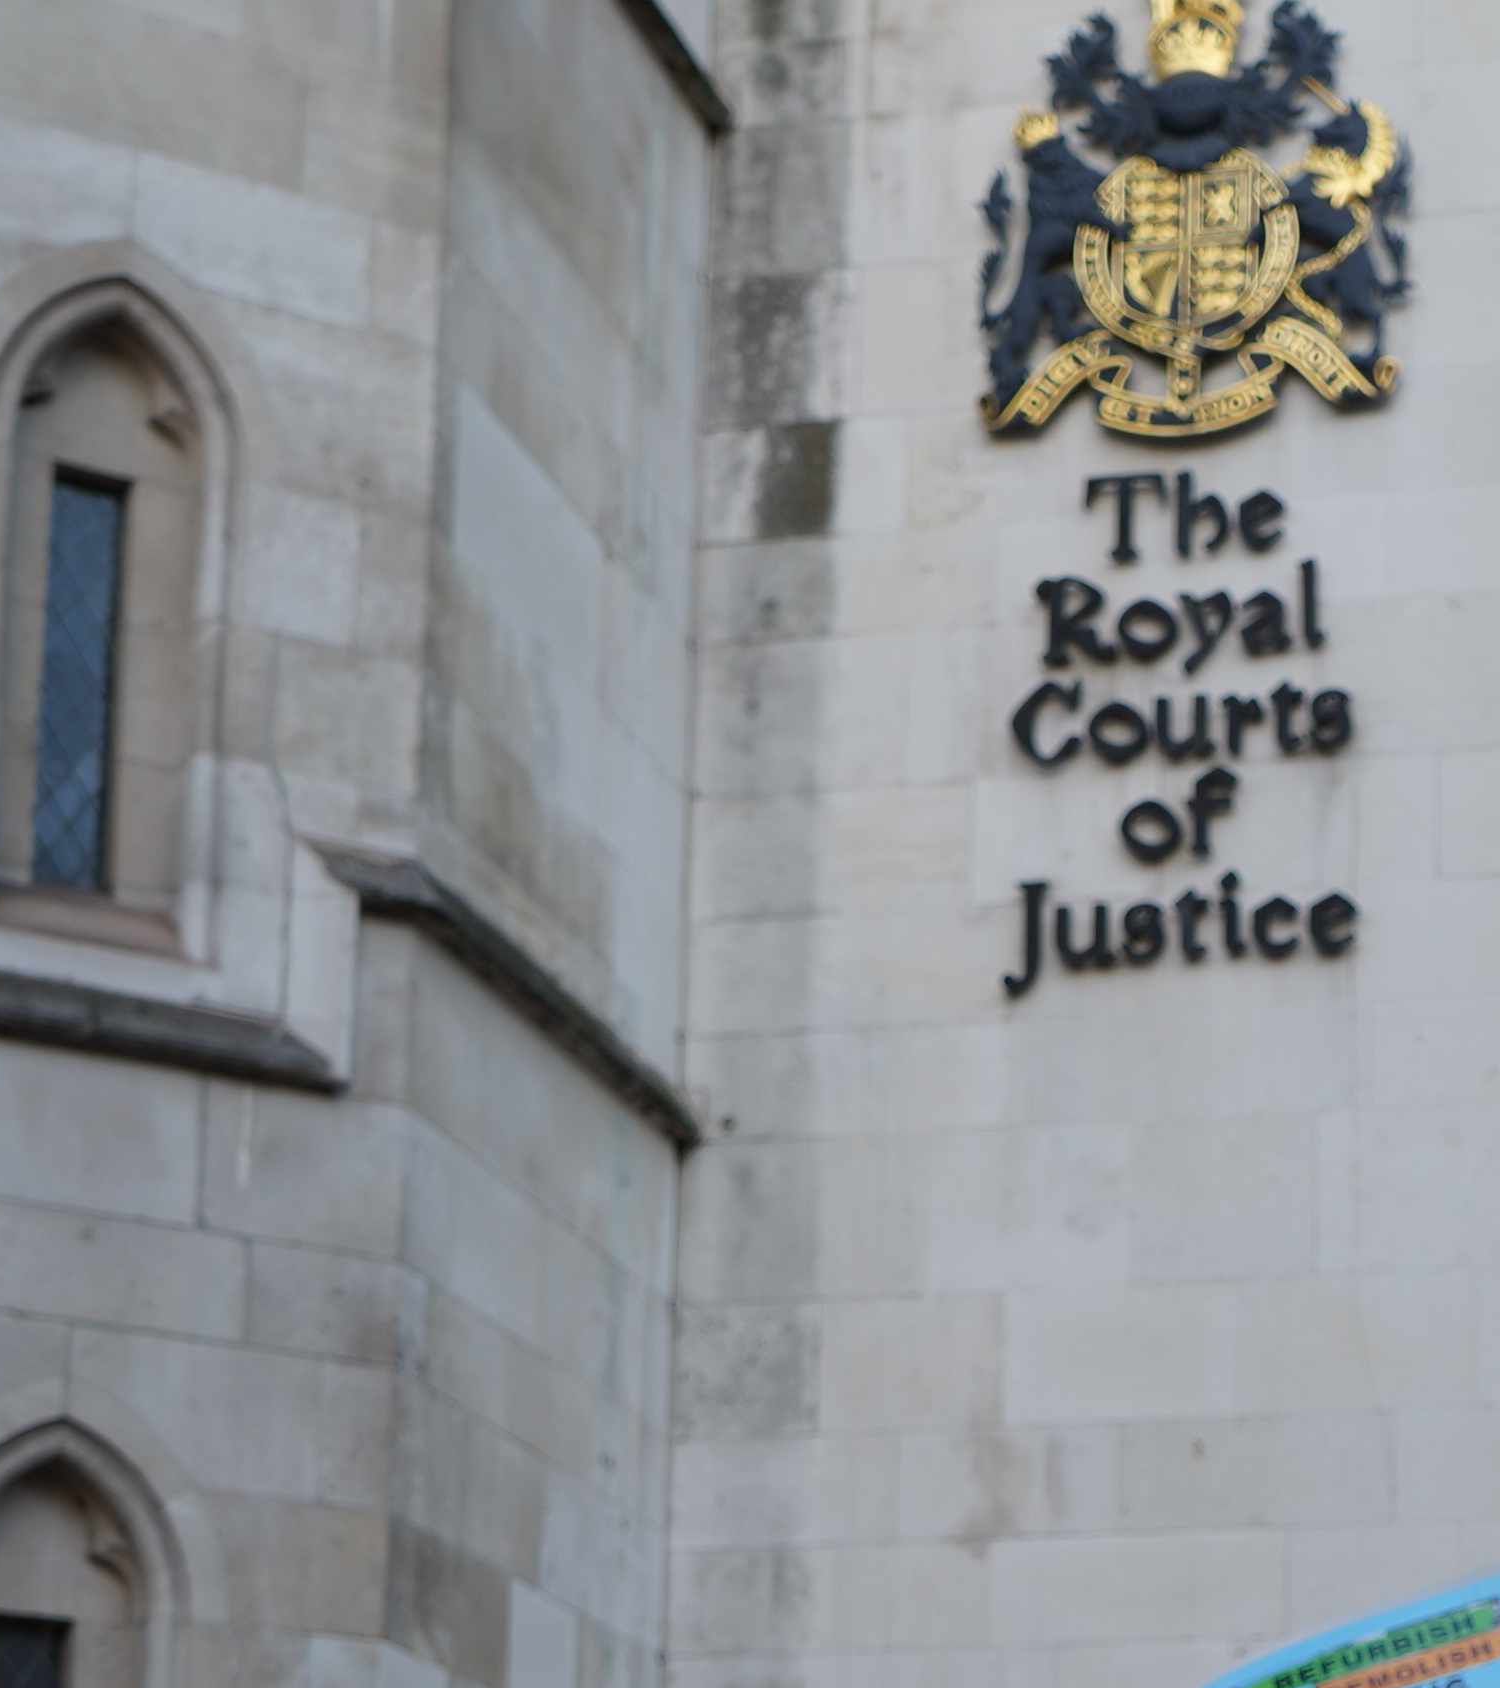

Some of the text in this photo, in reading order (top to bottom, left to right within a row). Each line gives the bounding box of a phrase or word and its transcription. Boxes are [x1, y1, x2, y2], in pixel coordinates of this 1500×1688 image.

[1086, 470, 1284, 564] The
[1036, 560, 1326, 673] Royal
[1012, 681, 1354, 771] Courts
[1120, 766, 1238, 863] of
[1004, 872, 1358, 997] Justice
